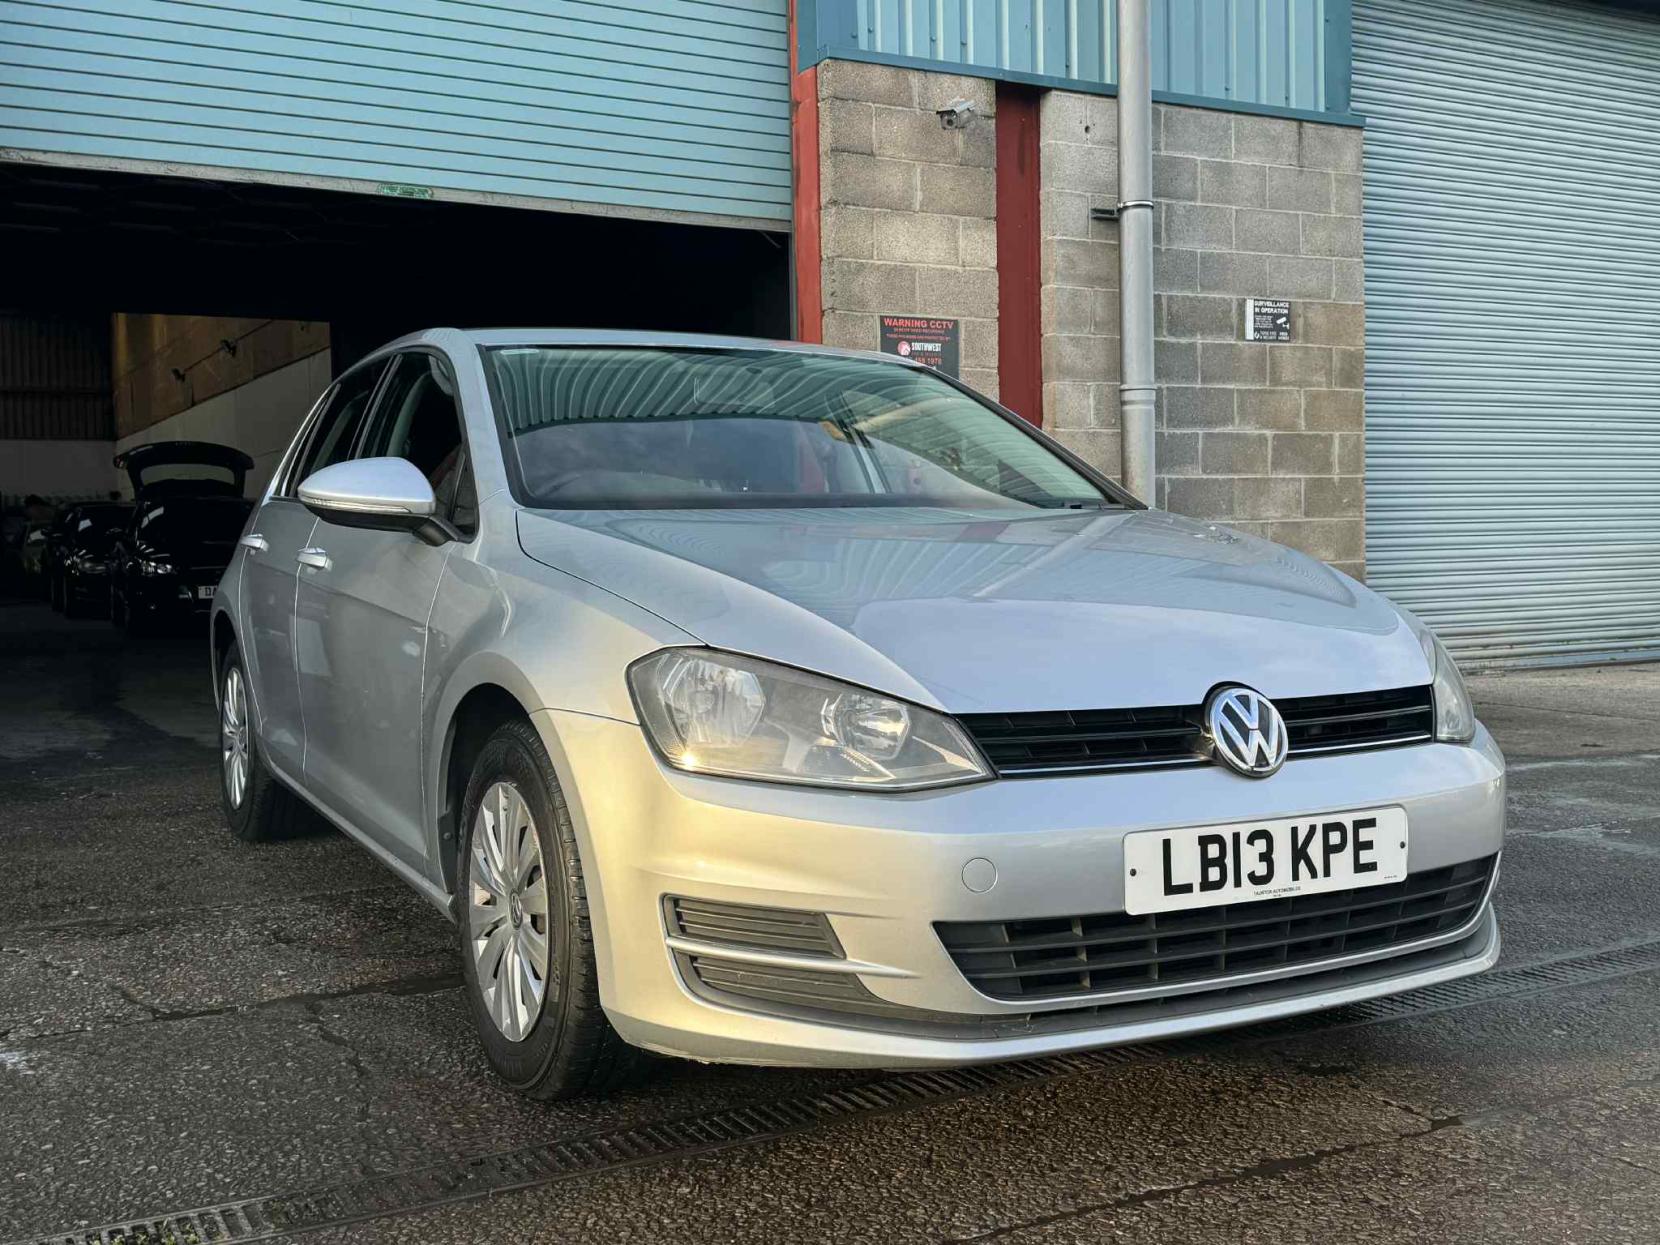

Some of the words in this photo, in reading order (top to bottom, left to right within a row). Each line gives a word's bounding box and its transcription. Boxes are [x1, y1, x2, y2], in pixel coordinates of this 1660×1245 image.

[884, 317, 928, 327] WARNING
[929, 320, 954, 329] CCTV
[911, 342, 942, 351] SOUTHWEST
[1162, 829, 1275, 896] LB13
[1290, 817, 1378, 882] KPE
